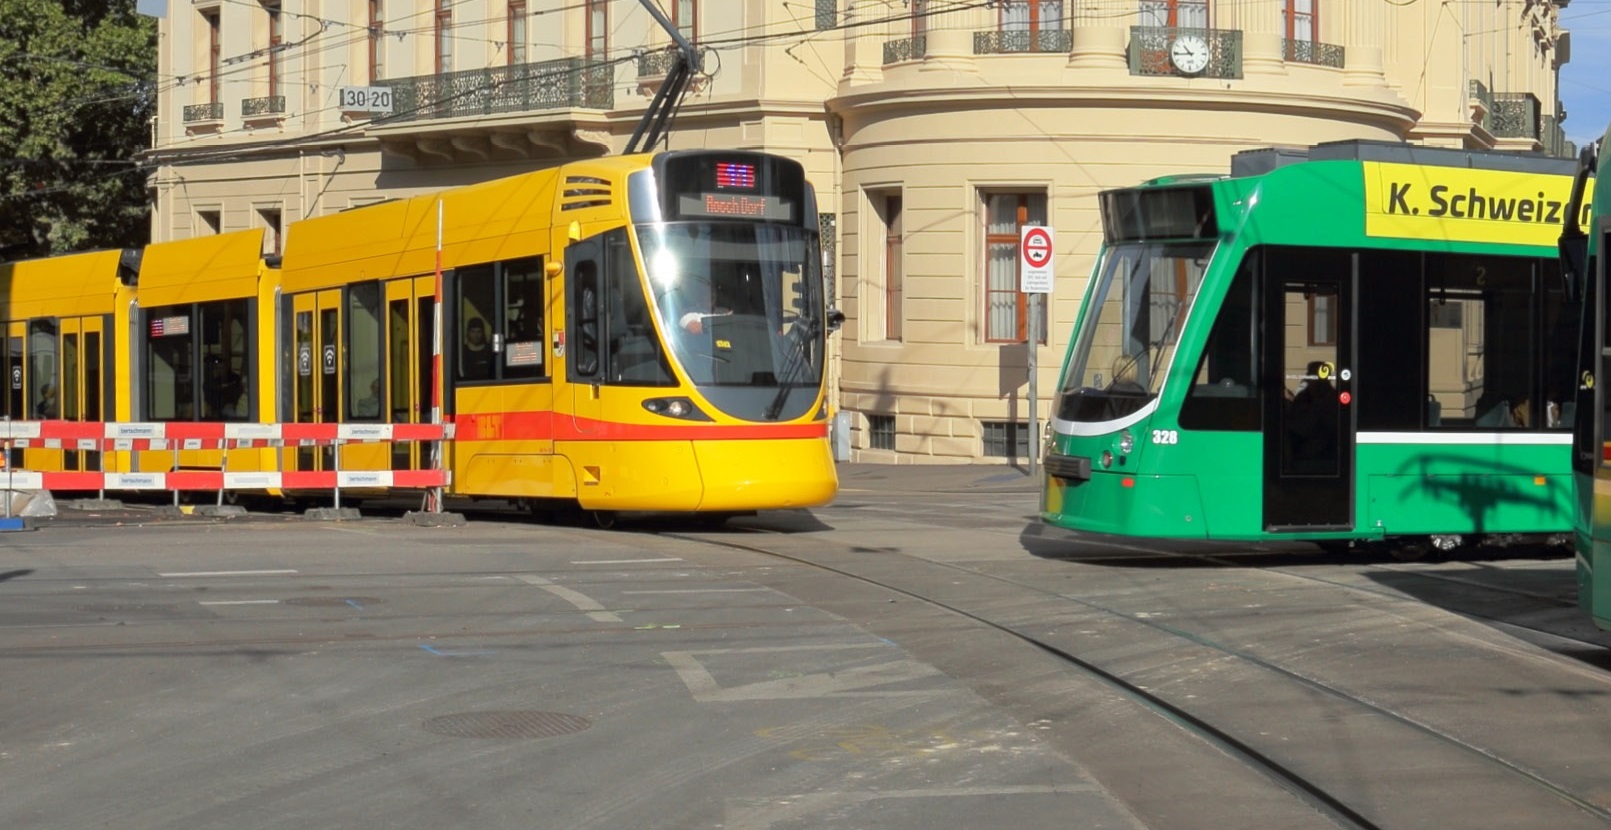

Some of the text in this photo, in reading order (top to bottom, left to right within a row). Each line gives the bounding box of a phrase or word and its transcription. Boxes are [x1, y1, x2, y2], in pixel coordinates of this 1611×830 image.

[347, 90, 390, 108] 30 20
[1388, 182, 1419, 215] K.
[1152, 429, 1178, 445] 328
